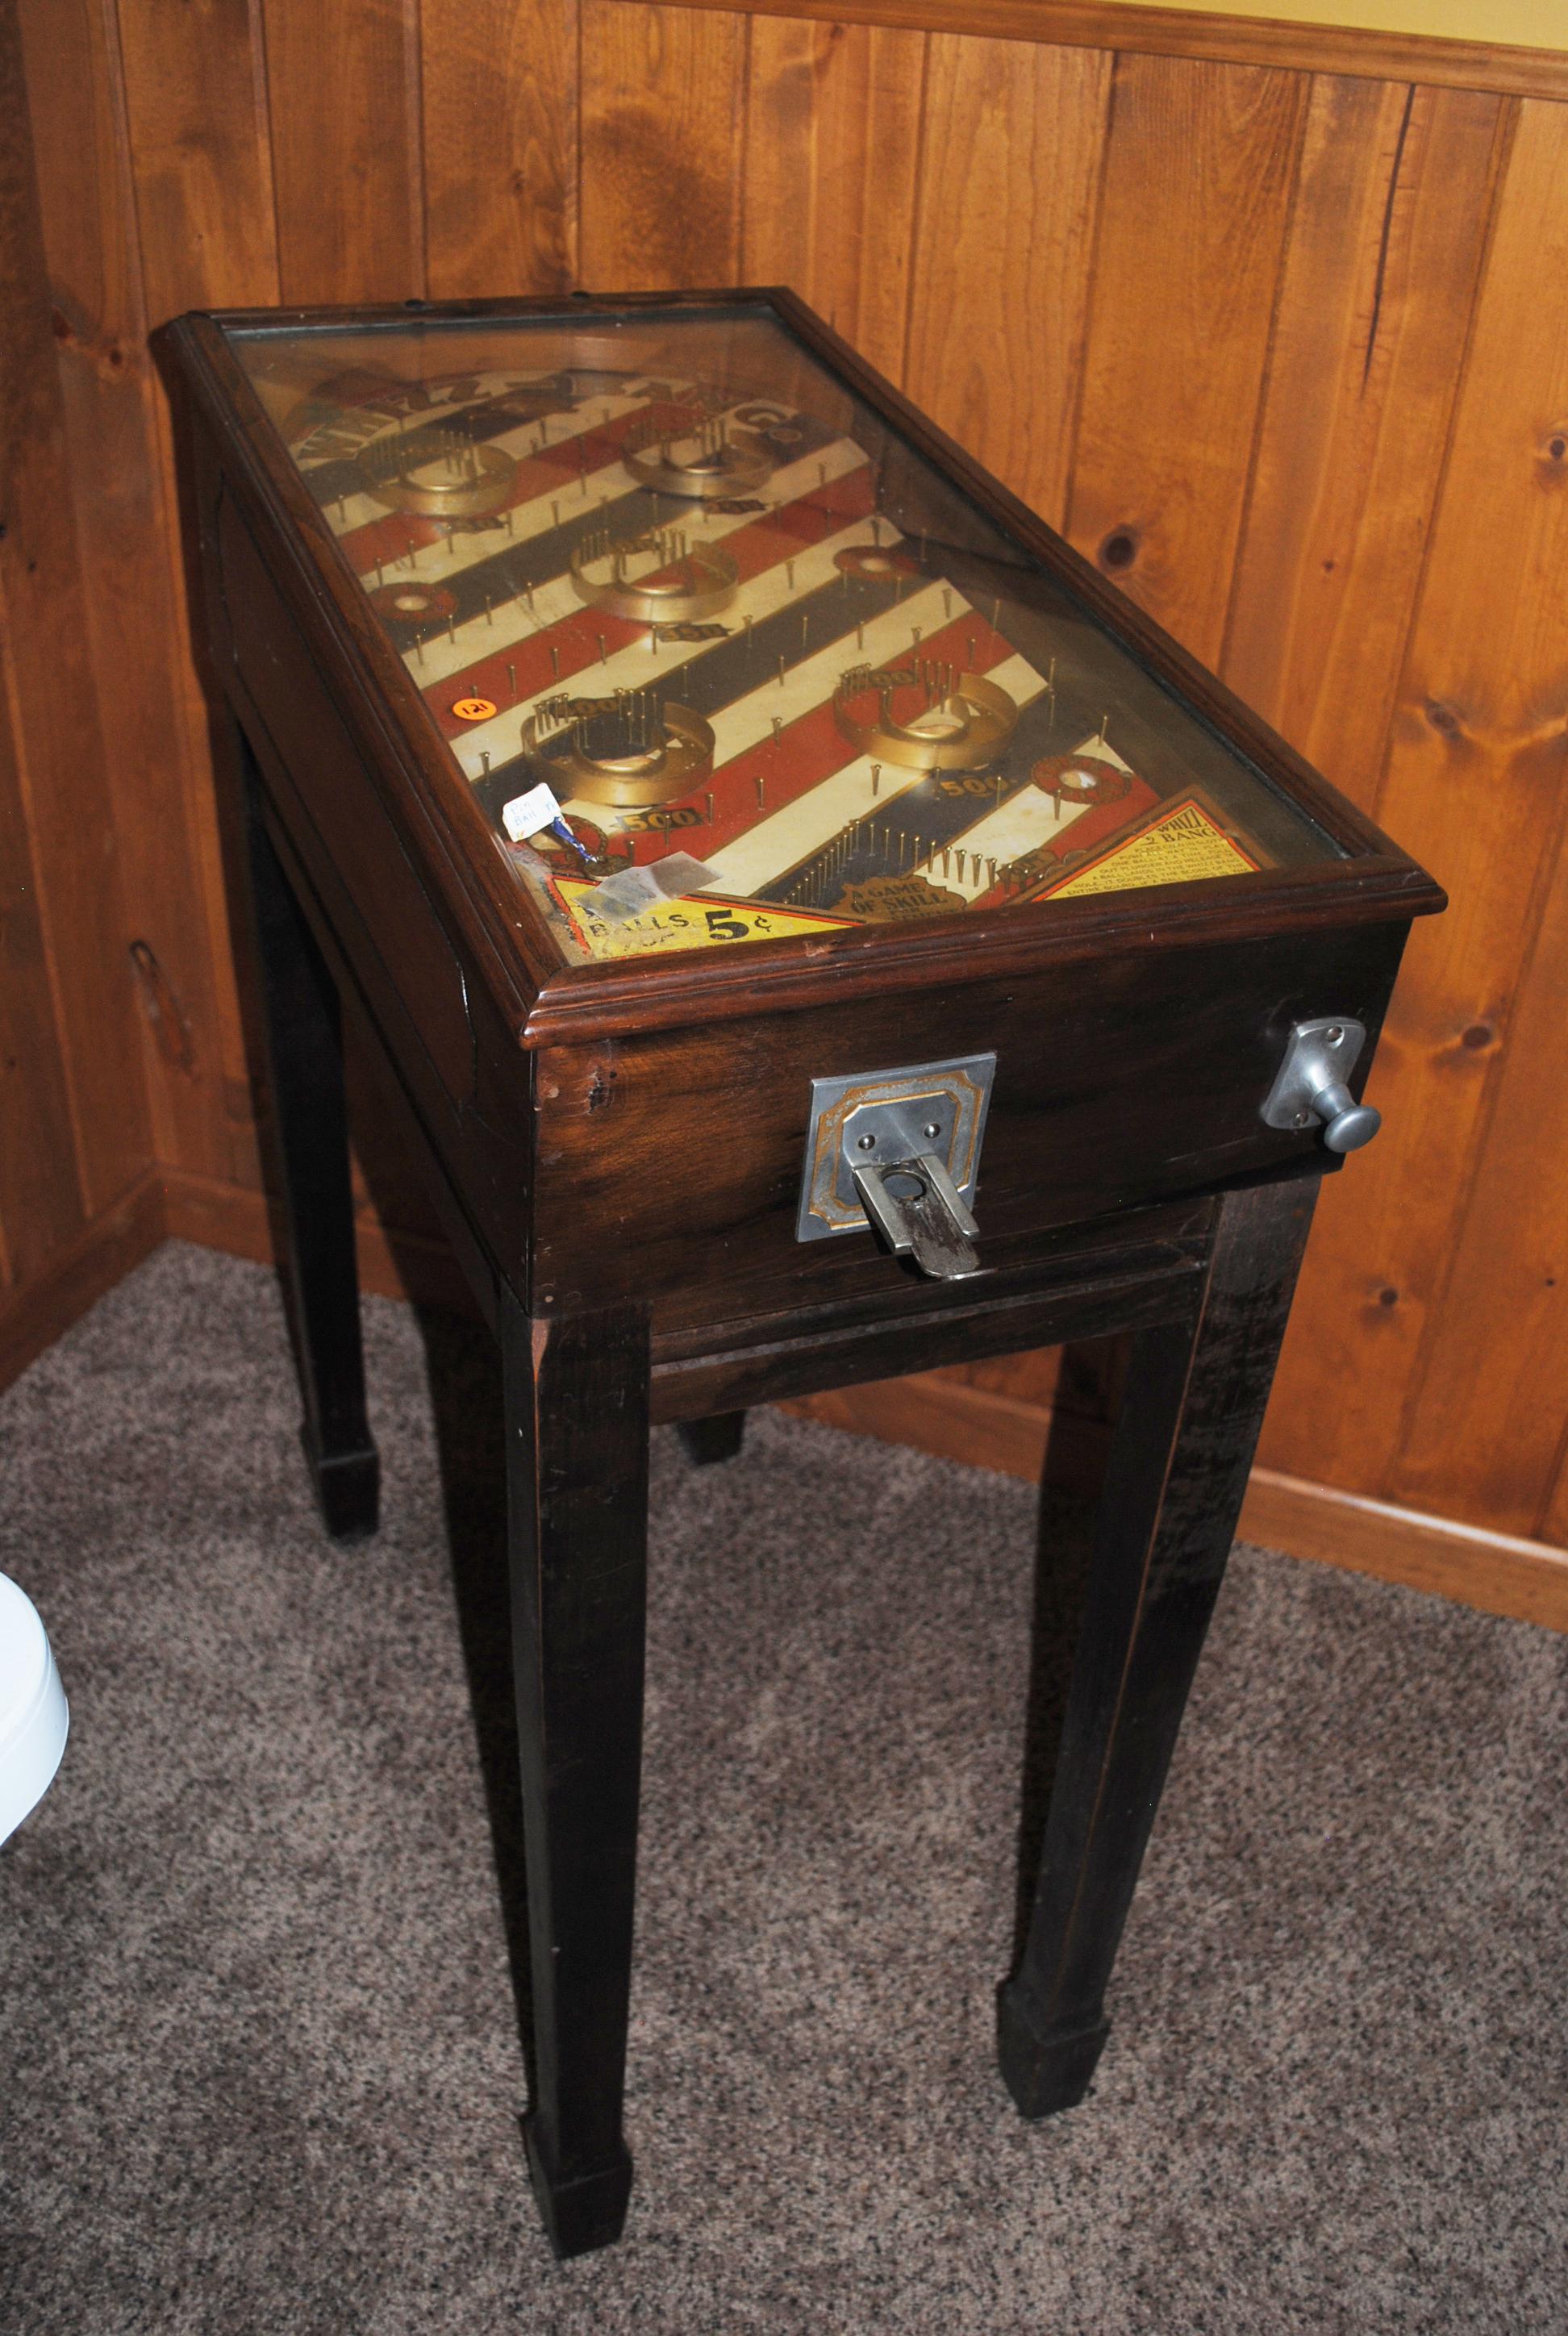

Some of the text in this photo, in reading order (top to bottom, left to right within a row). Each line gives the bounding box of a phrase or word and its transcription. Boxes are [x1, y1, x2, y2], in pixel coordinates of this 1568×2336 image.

[461, 703, 489, 715] 121
[940, 776, 1008, 797] 500
[623, 811, 699, 832] 500
[1157, 808, 1207, 833] WHIZZ
[1161, 829, 1216, 843] BANG
[867, 883, 926, 899] GAME
[851, 893, 949, 914] OF SKILL
